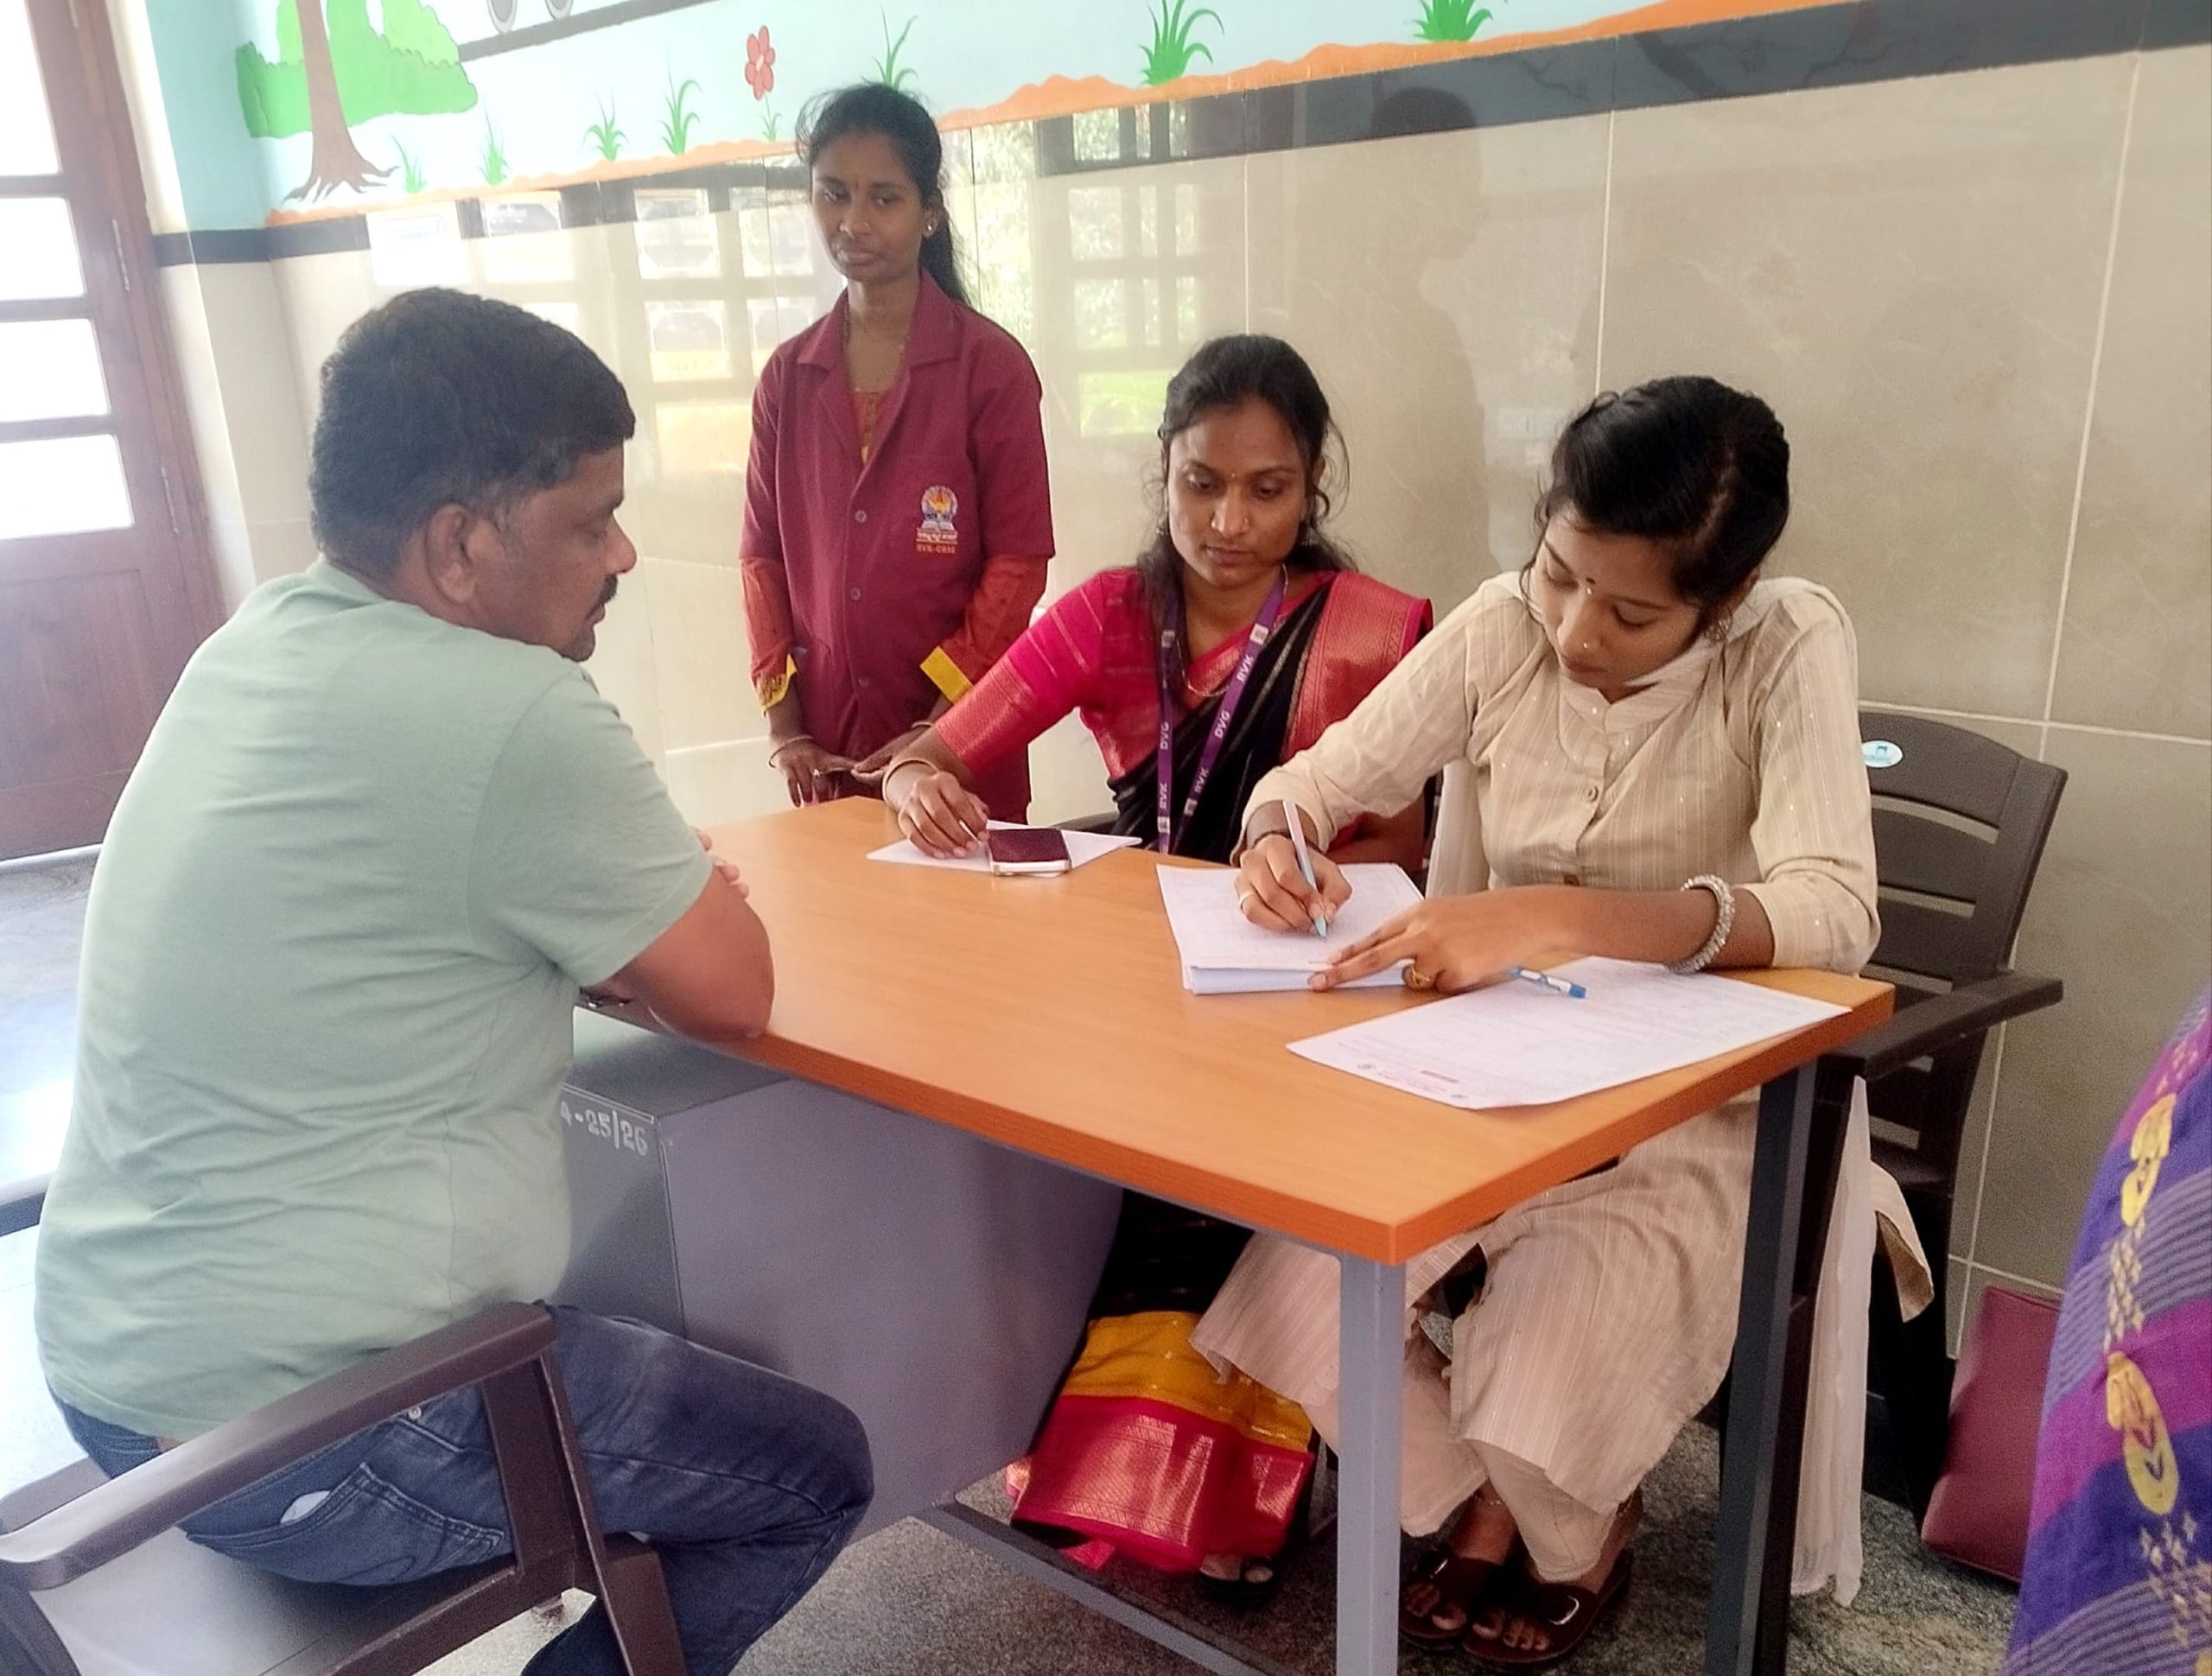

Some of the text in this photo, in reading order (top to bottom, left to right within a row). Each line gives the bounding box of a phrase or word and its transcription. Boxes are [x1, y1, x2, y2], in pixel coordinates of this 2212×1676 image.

[1214, 709, 1230, 739] DVG
[1236, 655, 1255, 683] RVK
[1160, 721, 1169, 750] DVG
